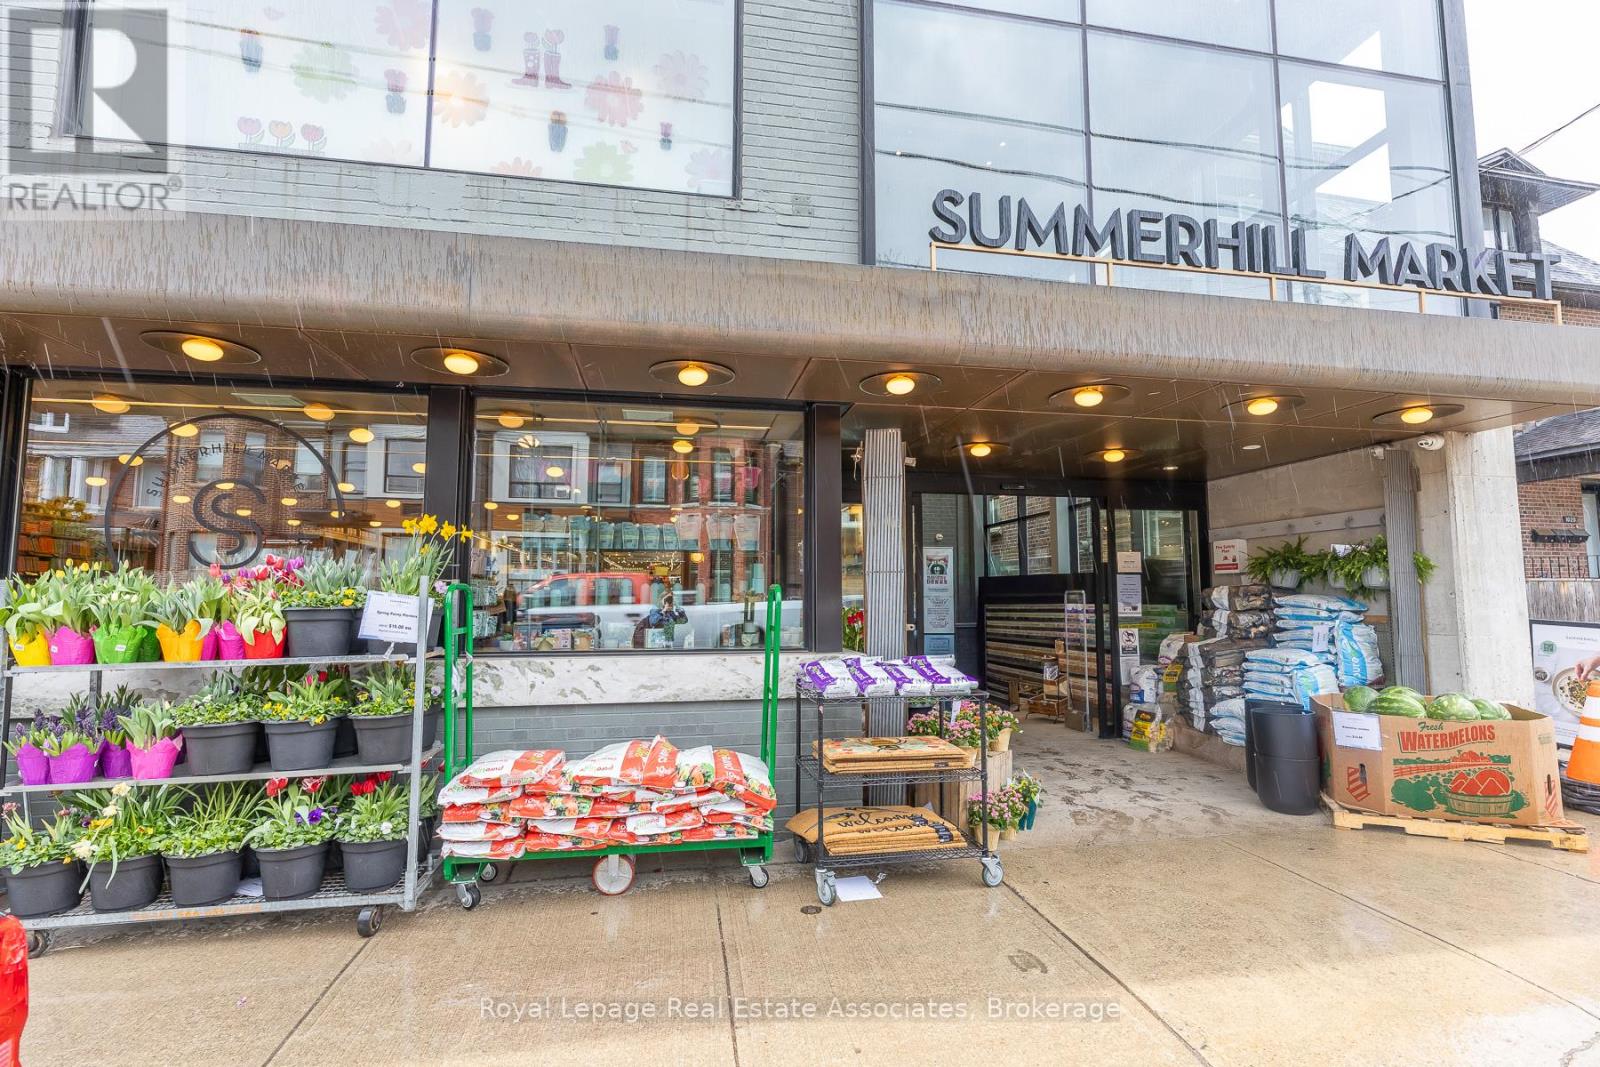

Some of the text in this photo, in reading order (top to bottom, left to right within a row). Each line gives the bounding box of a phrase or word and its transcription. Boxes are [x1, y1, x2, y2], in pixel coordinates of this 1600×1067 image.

[928, 188, 1561, 300] SUMMERHILL MARKET
[1398, 724, 1495, 753] WATERMELONS
[1418, 721, 1444, 732] Fresh
